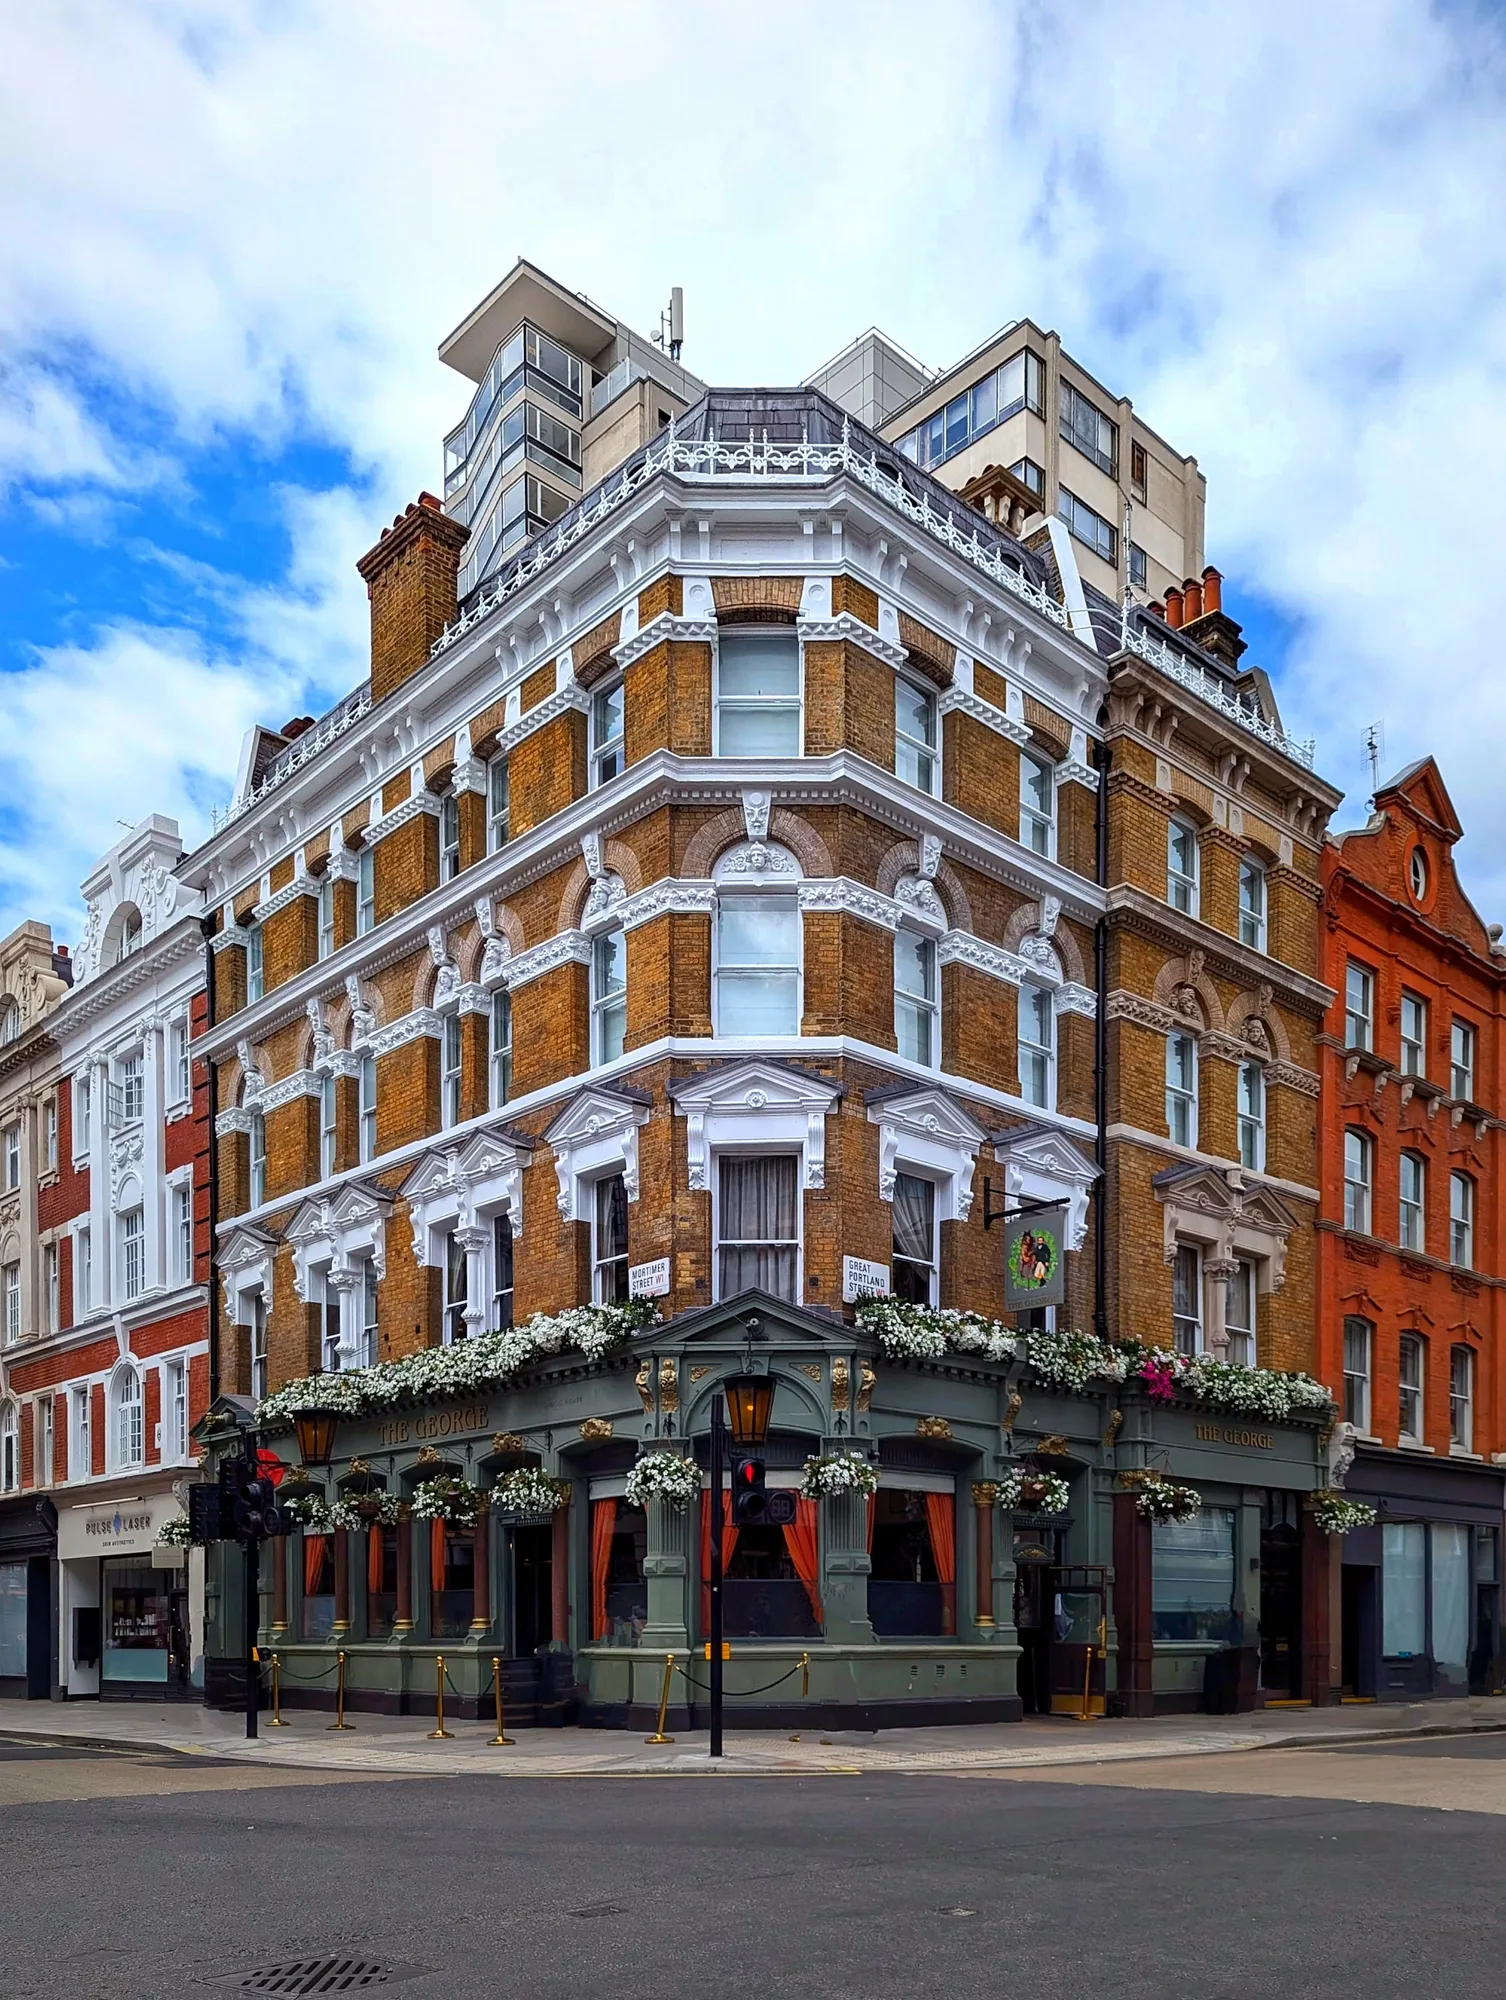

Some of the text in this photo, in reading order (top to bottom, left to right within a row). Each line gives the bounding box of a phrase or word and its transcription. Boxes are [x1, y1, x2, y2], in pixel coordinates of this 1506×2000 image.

[632, 1262, 665, 1279] MORTIMER
[849, 1260, 871, 1273] GREAT
[632, 1273, 664, 1290] STREET W1
[849, 1271, 885, 1287] PORTLAND
[849, 1282, 874, 1296] STREET
[378, 1405, 489, 1446] THE GEORGE
[1196, 1424, 1274, 1450] THE GEORGE
[86, 1516, 151, 1535] PULSE LASER
